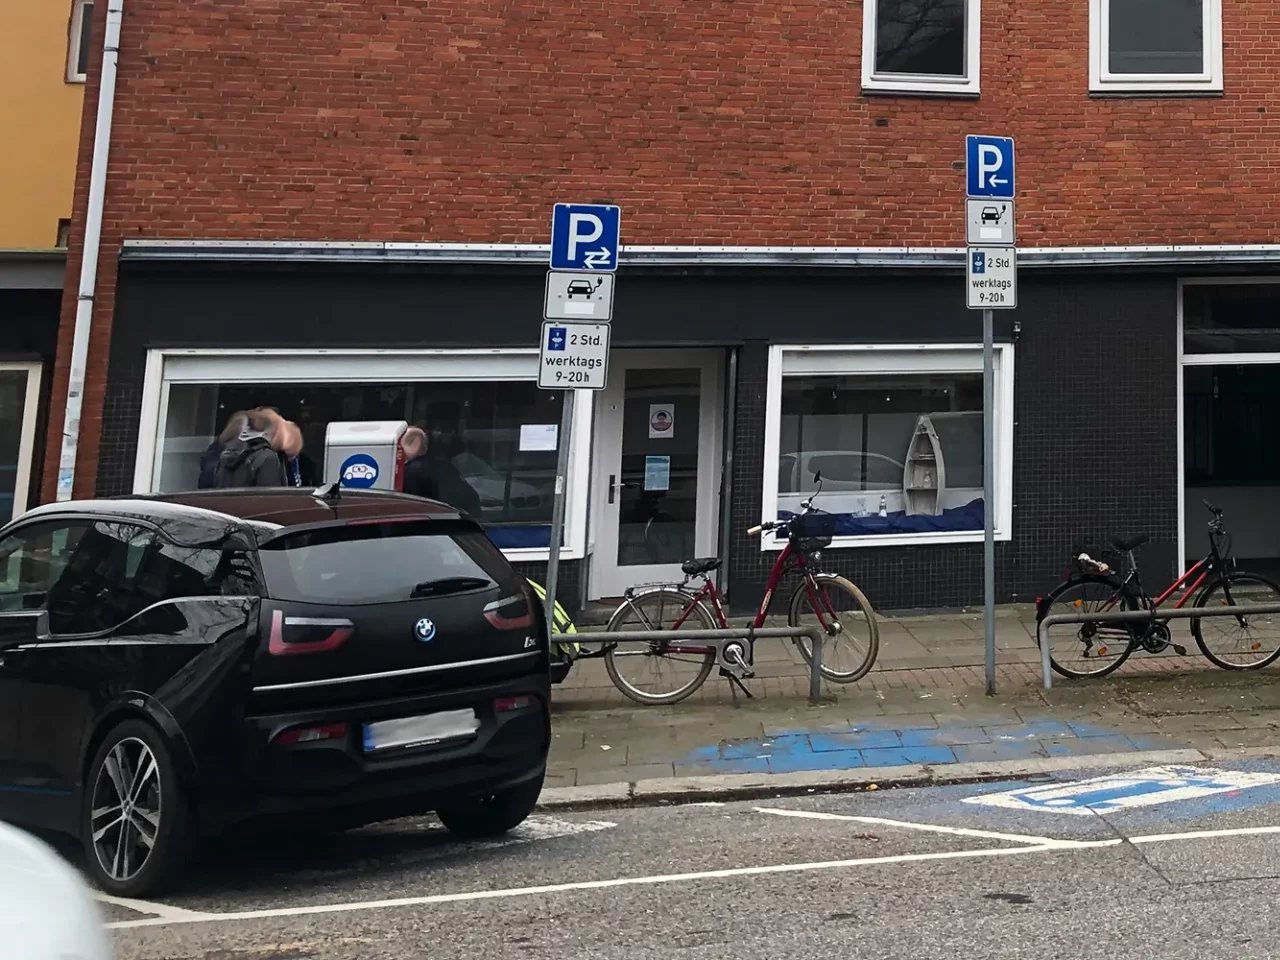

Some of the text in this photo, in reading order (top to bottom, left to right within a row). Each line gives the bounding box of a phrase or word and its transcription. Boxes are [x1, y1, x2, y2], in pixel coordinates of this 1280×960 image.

[978, 144, 1003, 189] P
[568, 213, 603, 261] P
[987, 258, 1012, 269] 2 Std.
[972, 278, 1012, 291] werktags
[570, 334, 603, 347] 2 Std.
[545, 355, 603, 370] werktags
